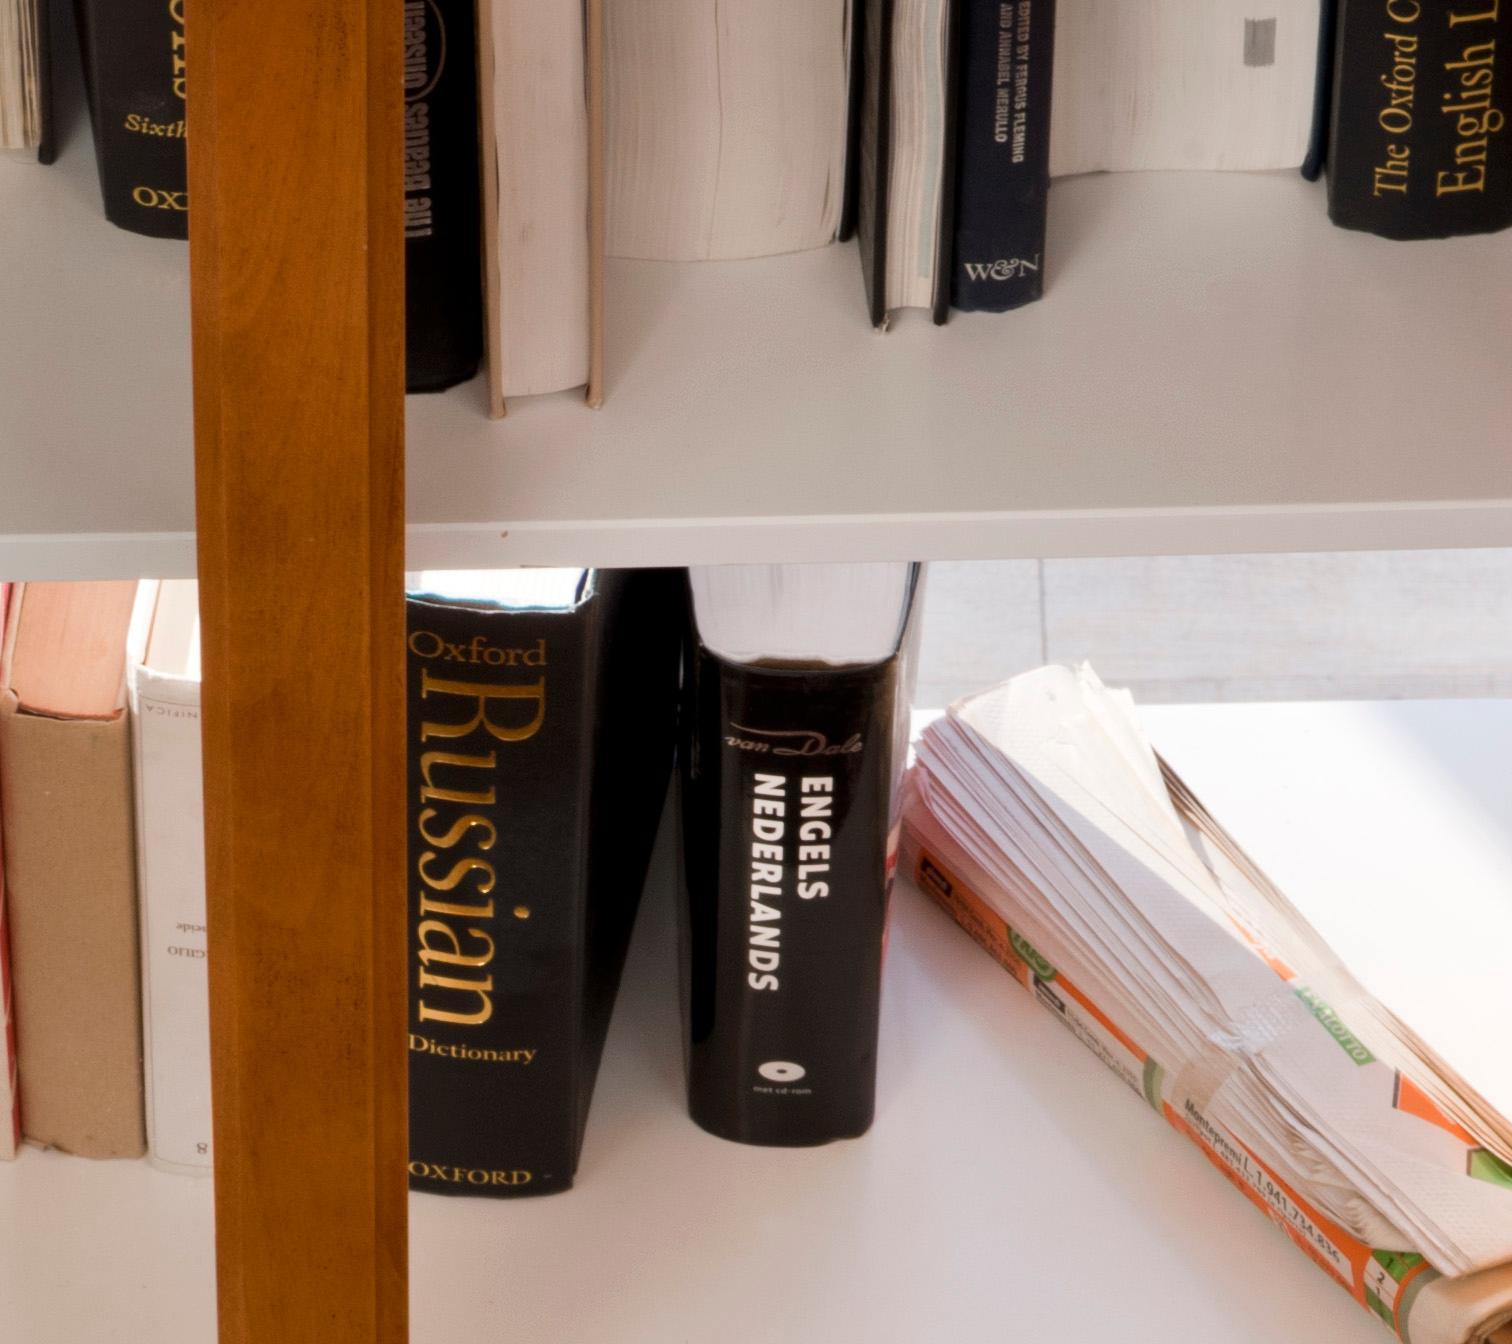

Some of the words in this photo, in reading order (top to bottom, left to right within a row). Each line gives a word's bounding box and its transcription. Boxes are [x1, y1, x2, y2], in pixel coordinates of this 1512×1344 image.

[1378, 33, 1420, 135] Oxford
[124, 112, 188, 138] Sixth
[404, 101, 432, 191] Beatles
[1011, 112, 1026, 164] FLEMING
[1435, 39, 1506, 198] English
[1372, 142, 1411, 197] The
[963, 252, 1040, 281] W&N
[408, 630, 547, 667] Oxford
[725, 733, 770, 755] van
[772, 726, 865, 758] Dale
[418, 668, 547, 1028] Russian
[797, 775, 834, 901] ENGELS
[747, 772, 787, 992] NEDERLANDS
[408, 1033, 538, 1065] Dictionary
[1183, 1097, 1244, 1166] Montepremi
[408, 1160, 533, 1186] OXFORD
